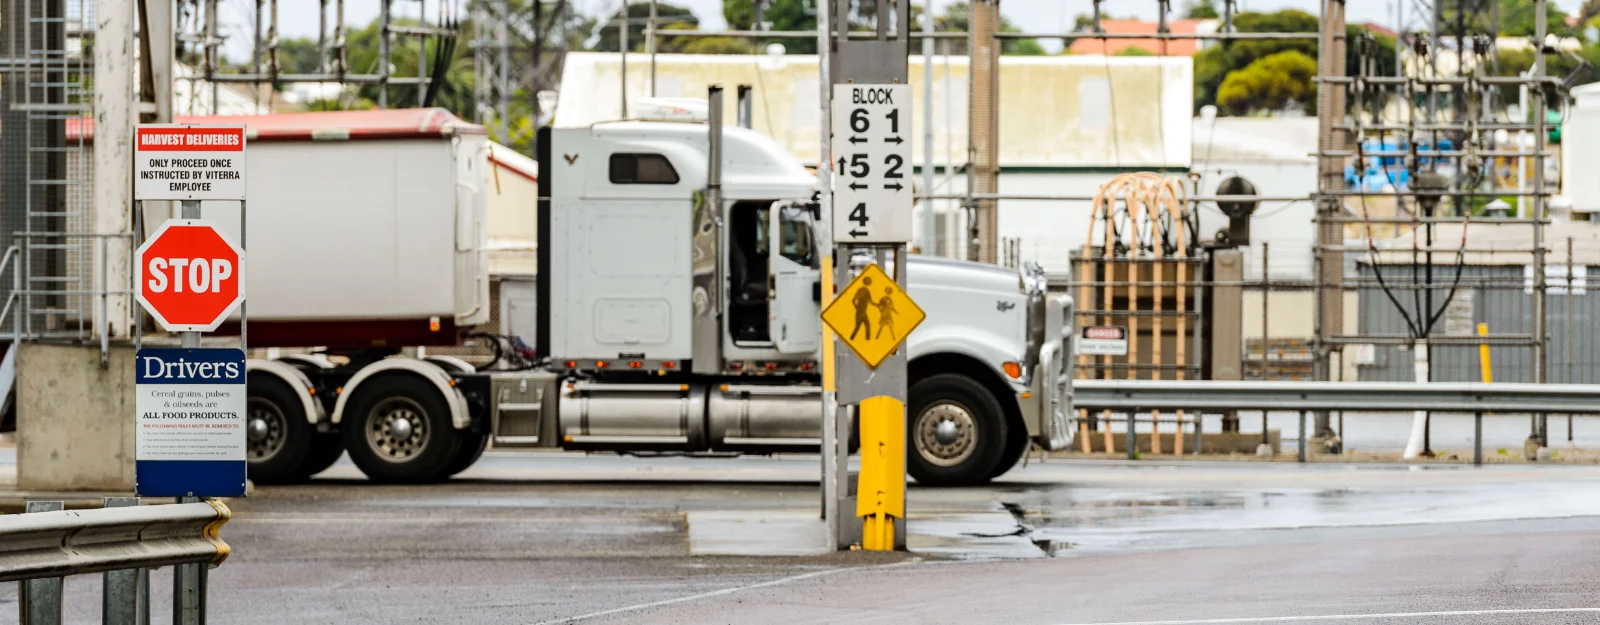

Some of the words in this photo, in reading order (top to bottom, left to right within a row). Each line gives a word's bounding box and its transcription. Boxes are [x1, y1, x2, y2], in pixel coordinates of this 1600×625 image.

[852, 88, 893, 104] BLOCK
[850, 108, 870, 133] 6
[885, 108, 899, 133] 1
[141, 134, 185, 146] HARVEST
[186, 134, 240, 146] DELIVERIES
[149, 159, 169, 168] ONLY
[171, 159, 208, 168] PROCEED
[210, 159, 232, 168] ONCE
[850, 153, 870, 178] 5
[883, 153, 904, 178] 2
[140, 170, 190, 179] INSTRUCTED
[192, 170, 203, 179] BY
[205, 170, 240, 179] VITERRA
[169, 182, 212, 191] EMPLOYEE
[848, 202, 869, 227] 4
[148, 257, 233, 294] STOP
[143, 356, 239, 379] Drivers
[151, 390, 176, 398] Cereal
[177, 390, 204, 399] grains,
[205, 390, 230, 399] pulses
